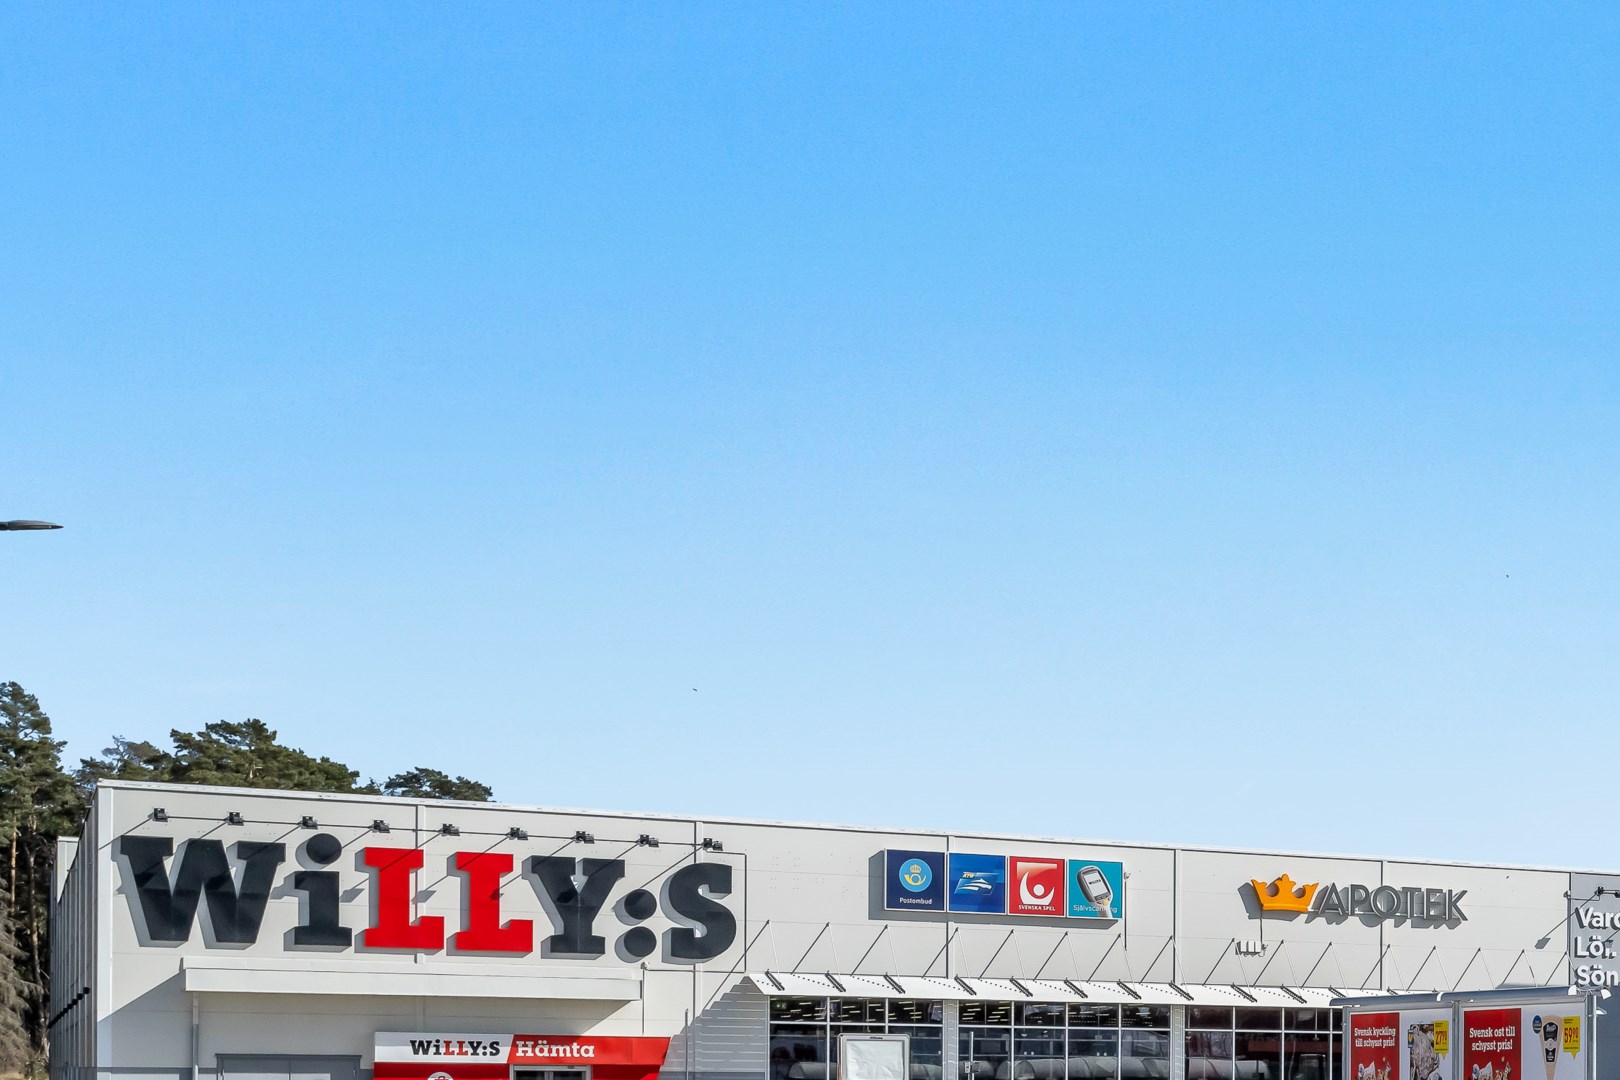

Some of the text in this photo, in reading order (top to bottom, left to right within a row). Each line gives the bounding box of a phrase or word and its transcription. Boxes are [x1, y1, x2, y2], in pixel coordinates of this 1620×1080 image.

[899, 897, 933, 905] Postombud
[1318, 881, 1469, 922] APOTEK
[1576, 935, 1617, 957] Lör.
[1354, 1026, 1396, 1038] Svensk kyckling
[1469, 1026, 1516, 1038] Svensk ost till
[515, 1040, 595, 1058] Hämta
[1363, 1038, 1382, 1048] schysst
[1383, 1038, 1395, 1048] pris!
[1472, 1039, 1513, 1052] schysst pris!
